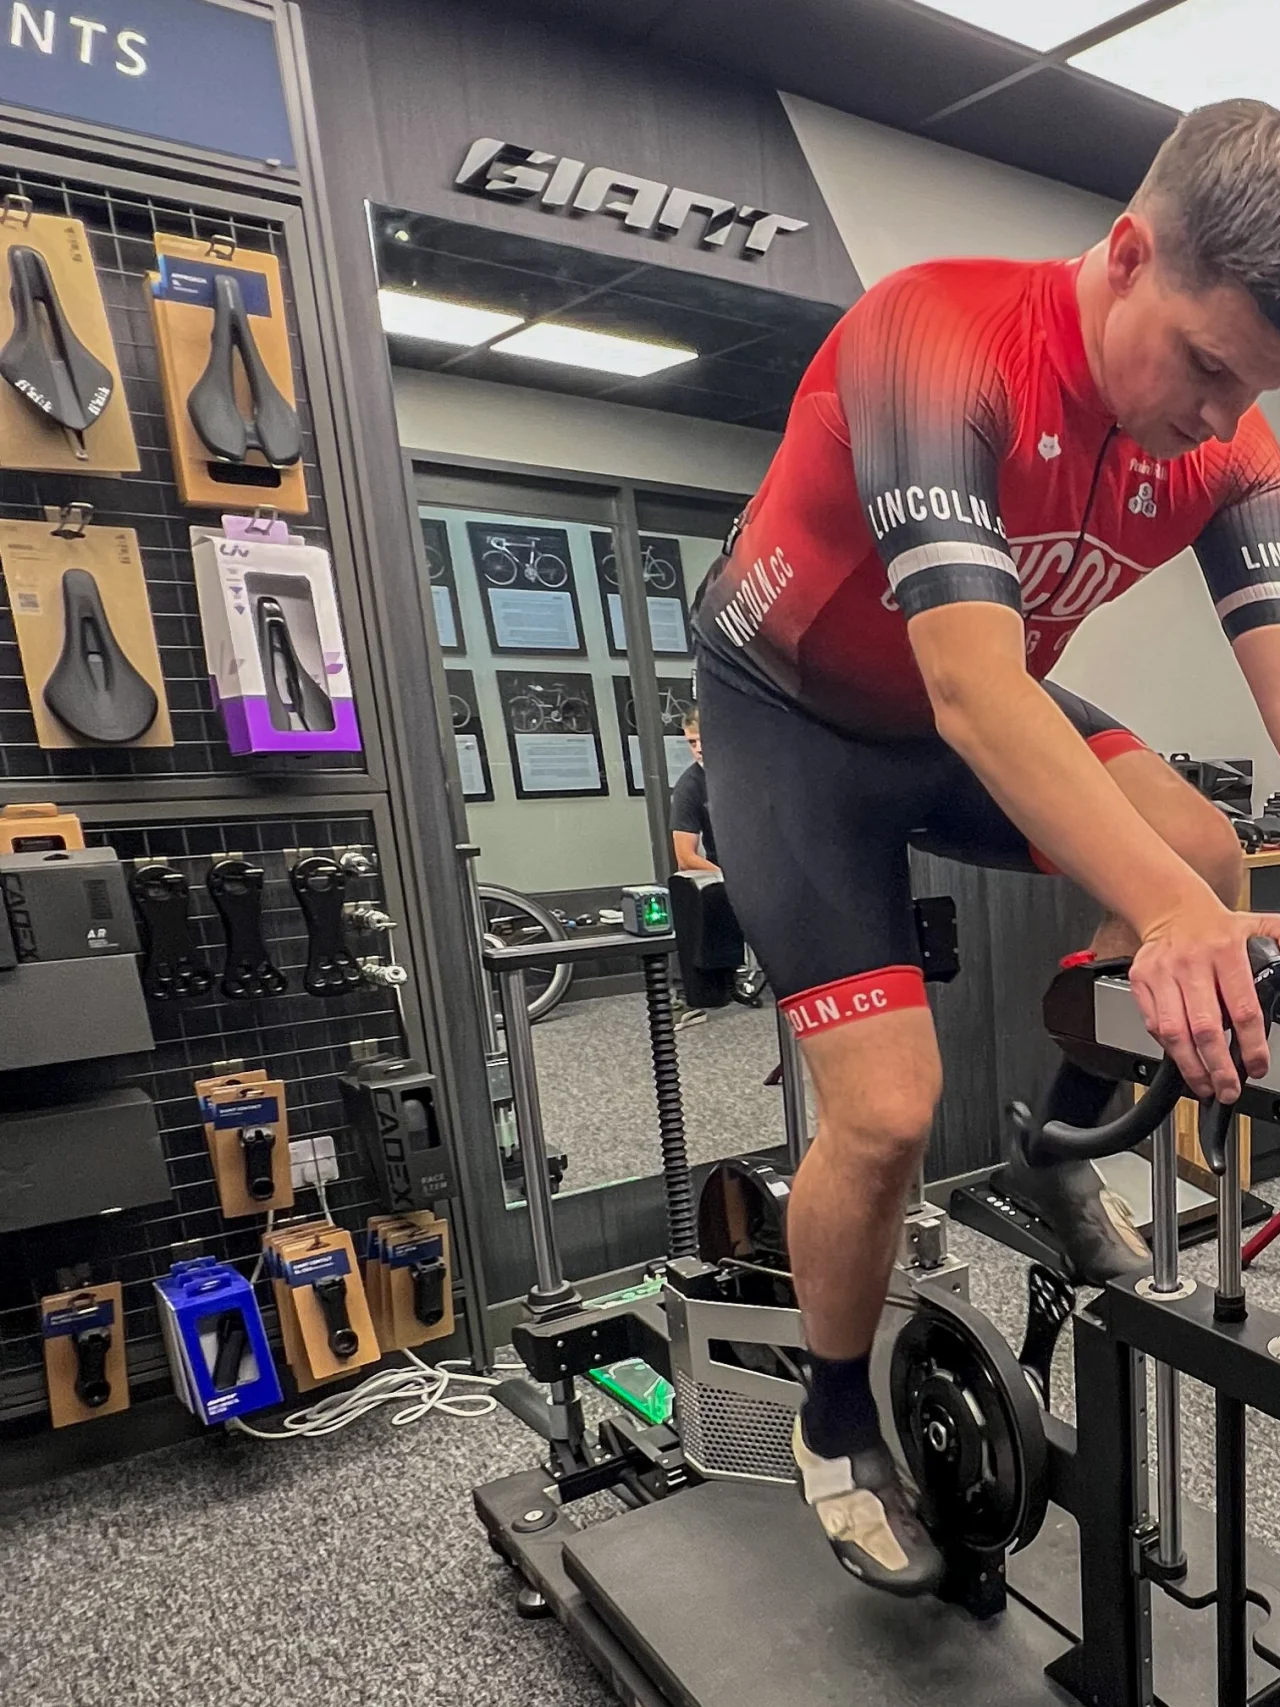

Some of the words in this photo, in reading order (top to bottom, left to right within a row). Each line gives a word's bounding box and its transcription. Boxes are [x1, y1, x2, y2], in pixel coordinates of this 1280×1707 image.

[10, 1, 149, 77] NTS
[455, 137, 809, 254] GIANT
[784, 988, 887, 1033] OLN.CC
[373, 1087, 415, 1205] CADEX
